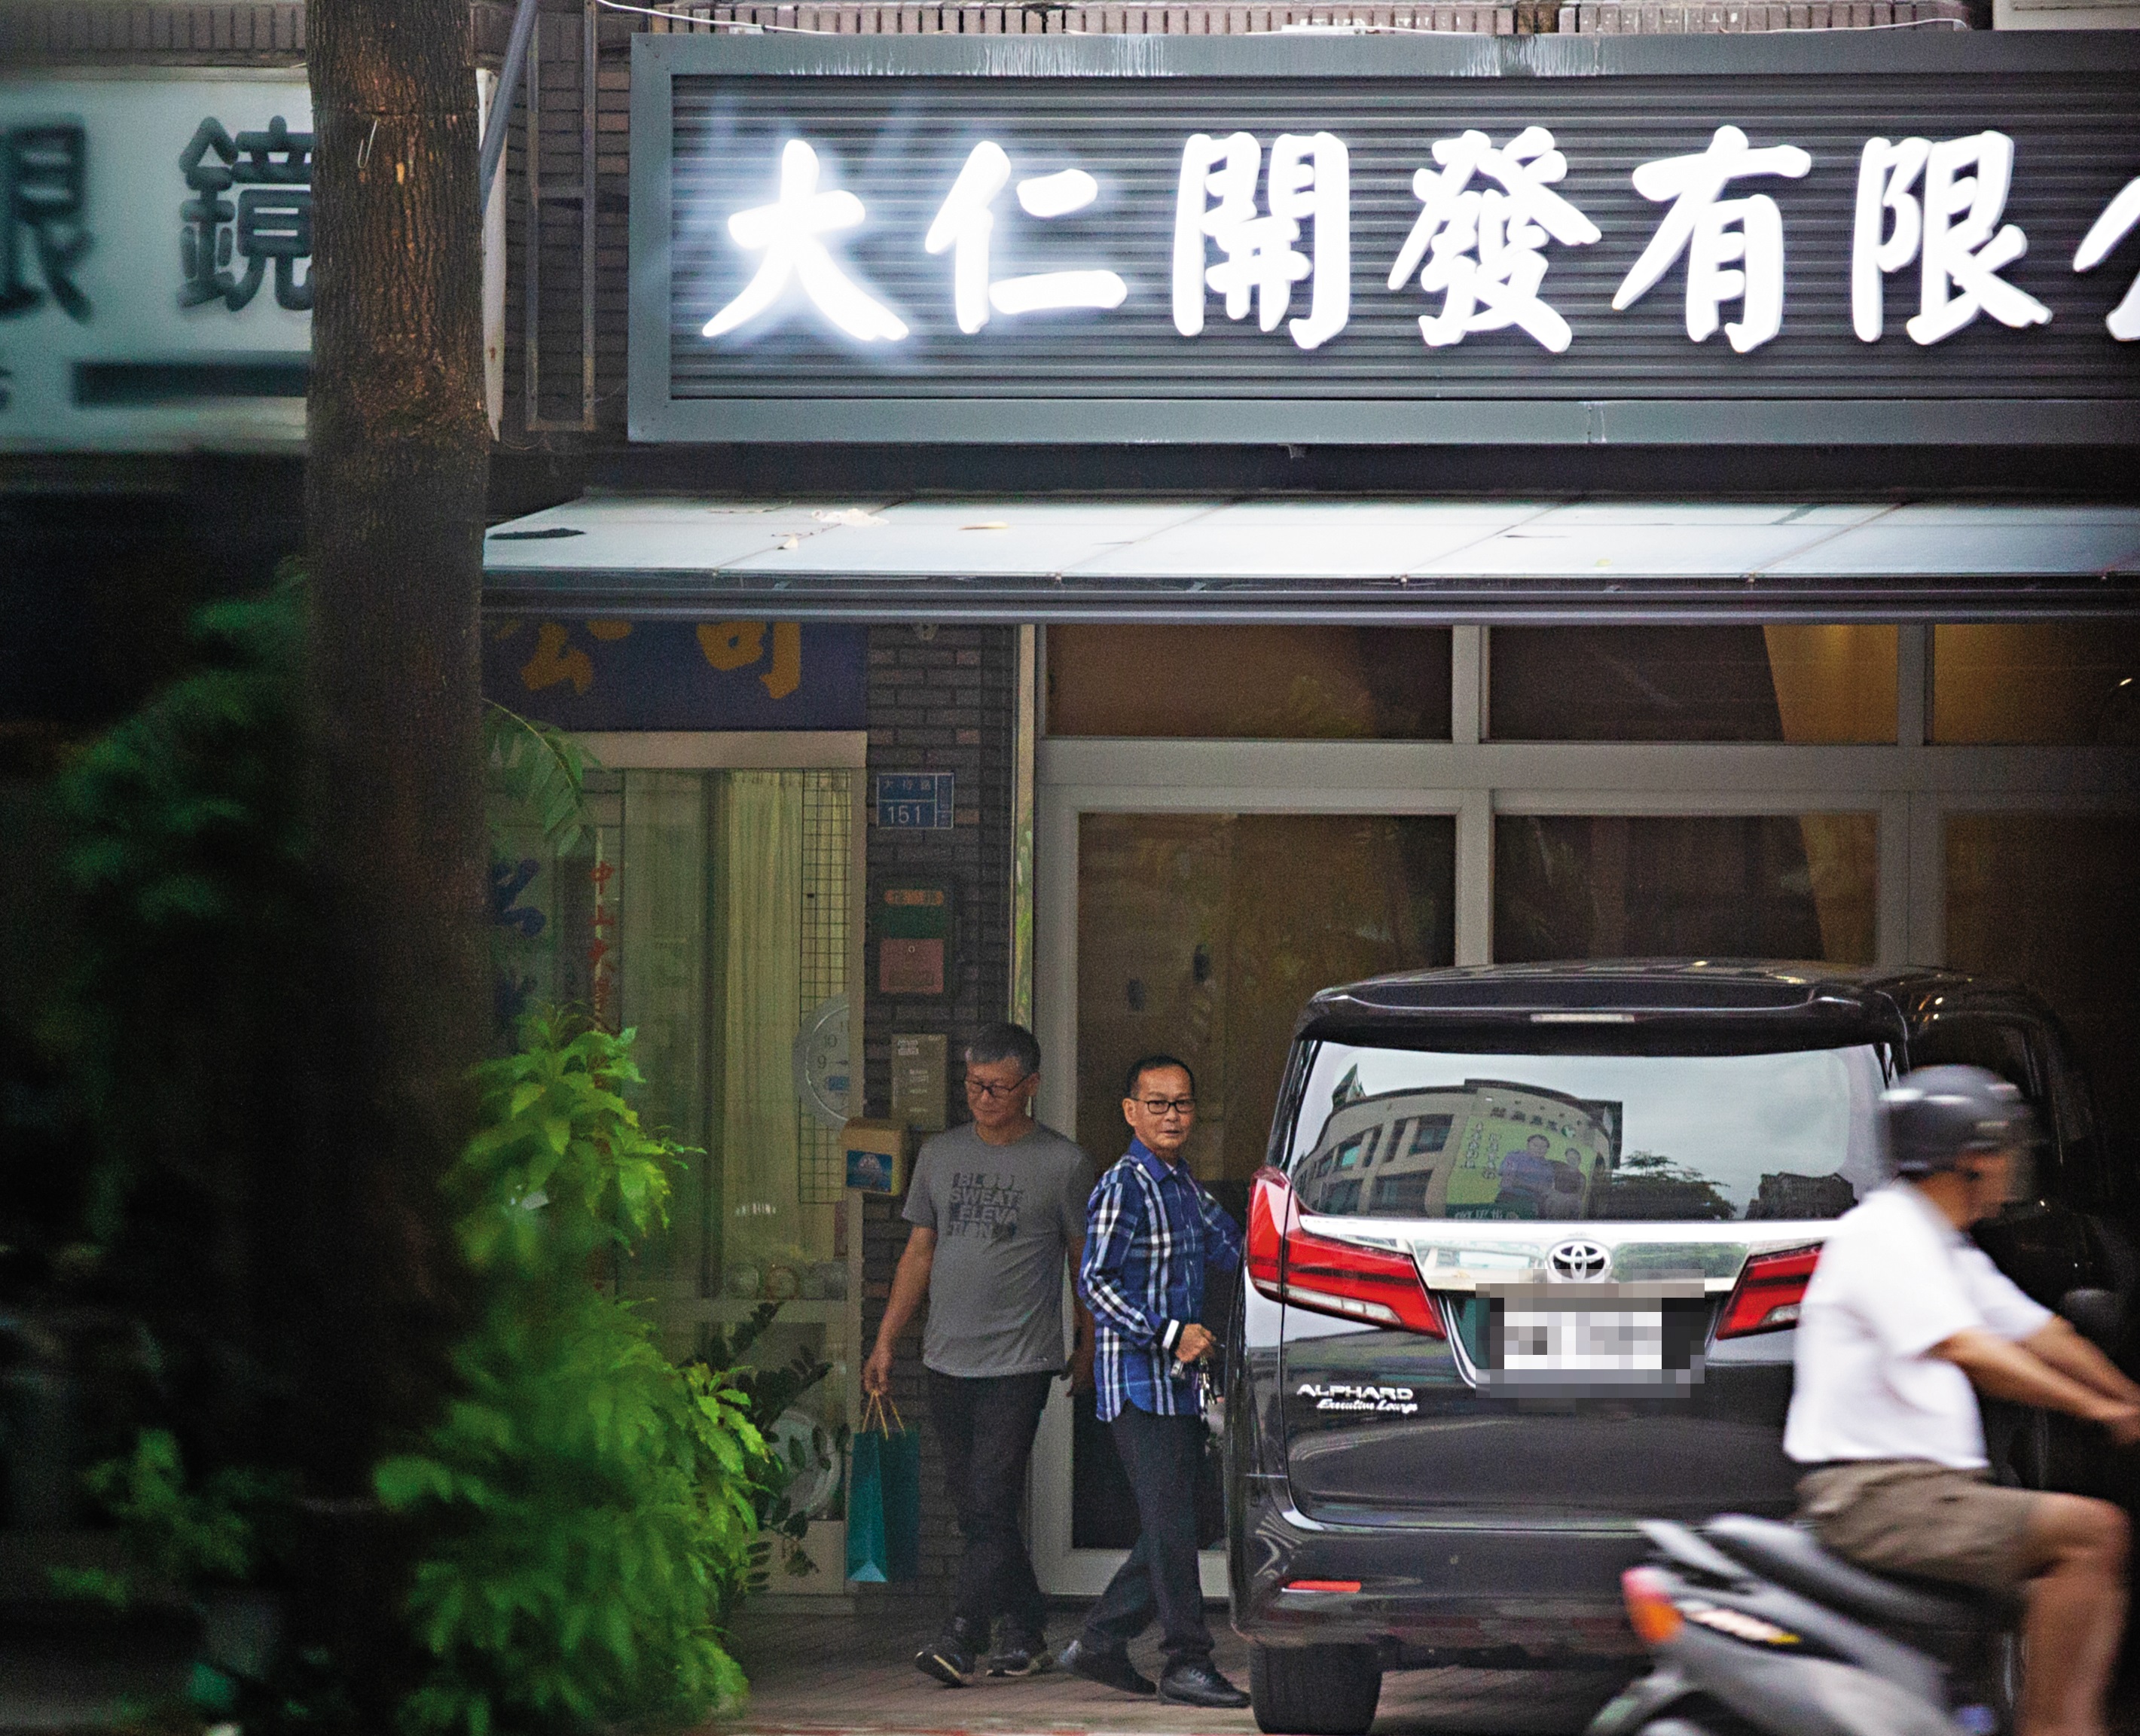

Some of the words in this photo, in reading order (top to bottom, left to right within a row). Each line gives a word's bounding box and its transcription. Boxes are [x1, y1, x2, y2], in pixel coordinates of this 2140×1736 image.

[887, 804, 921, 825] 151
[817, 1054, 827, 1069] 9
[949, 1186, 1019, 1208] SWEAT
[958, 1204, 1018, 1225] ELEVA
[1296, 1383, 1414, 1401] ALPHARD
